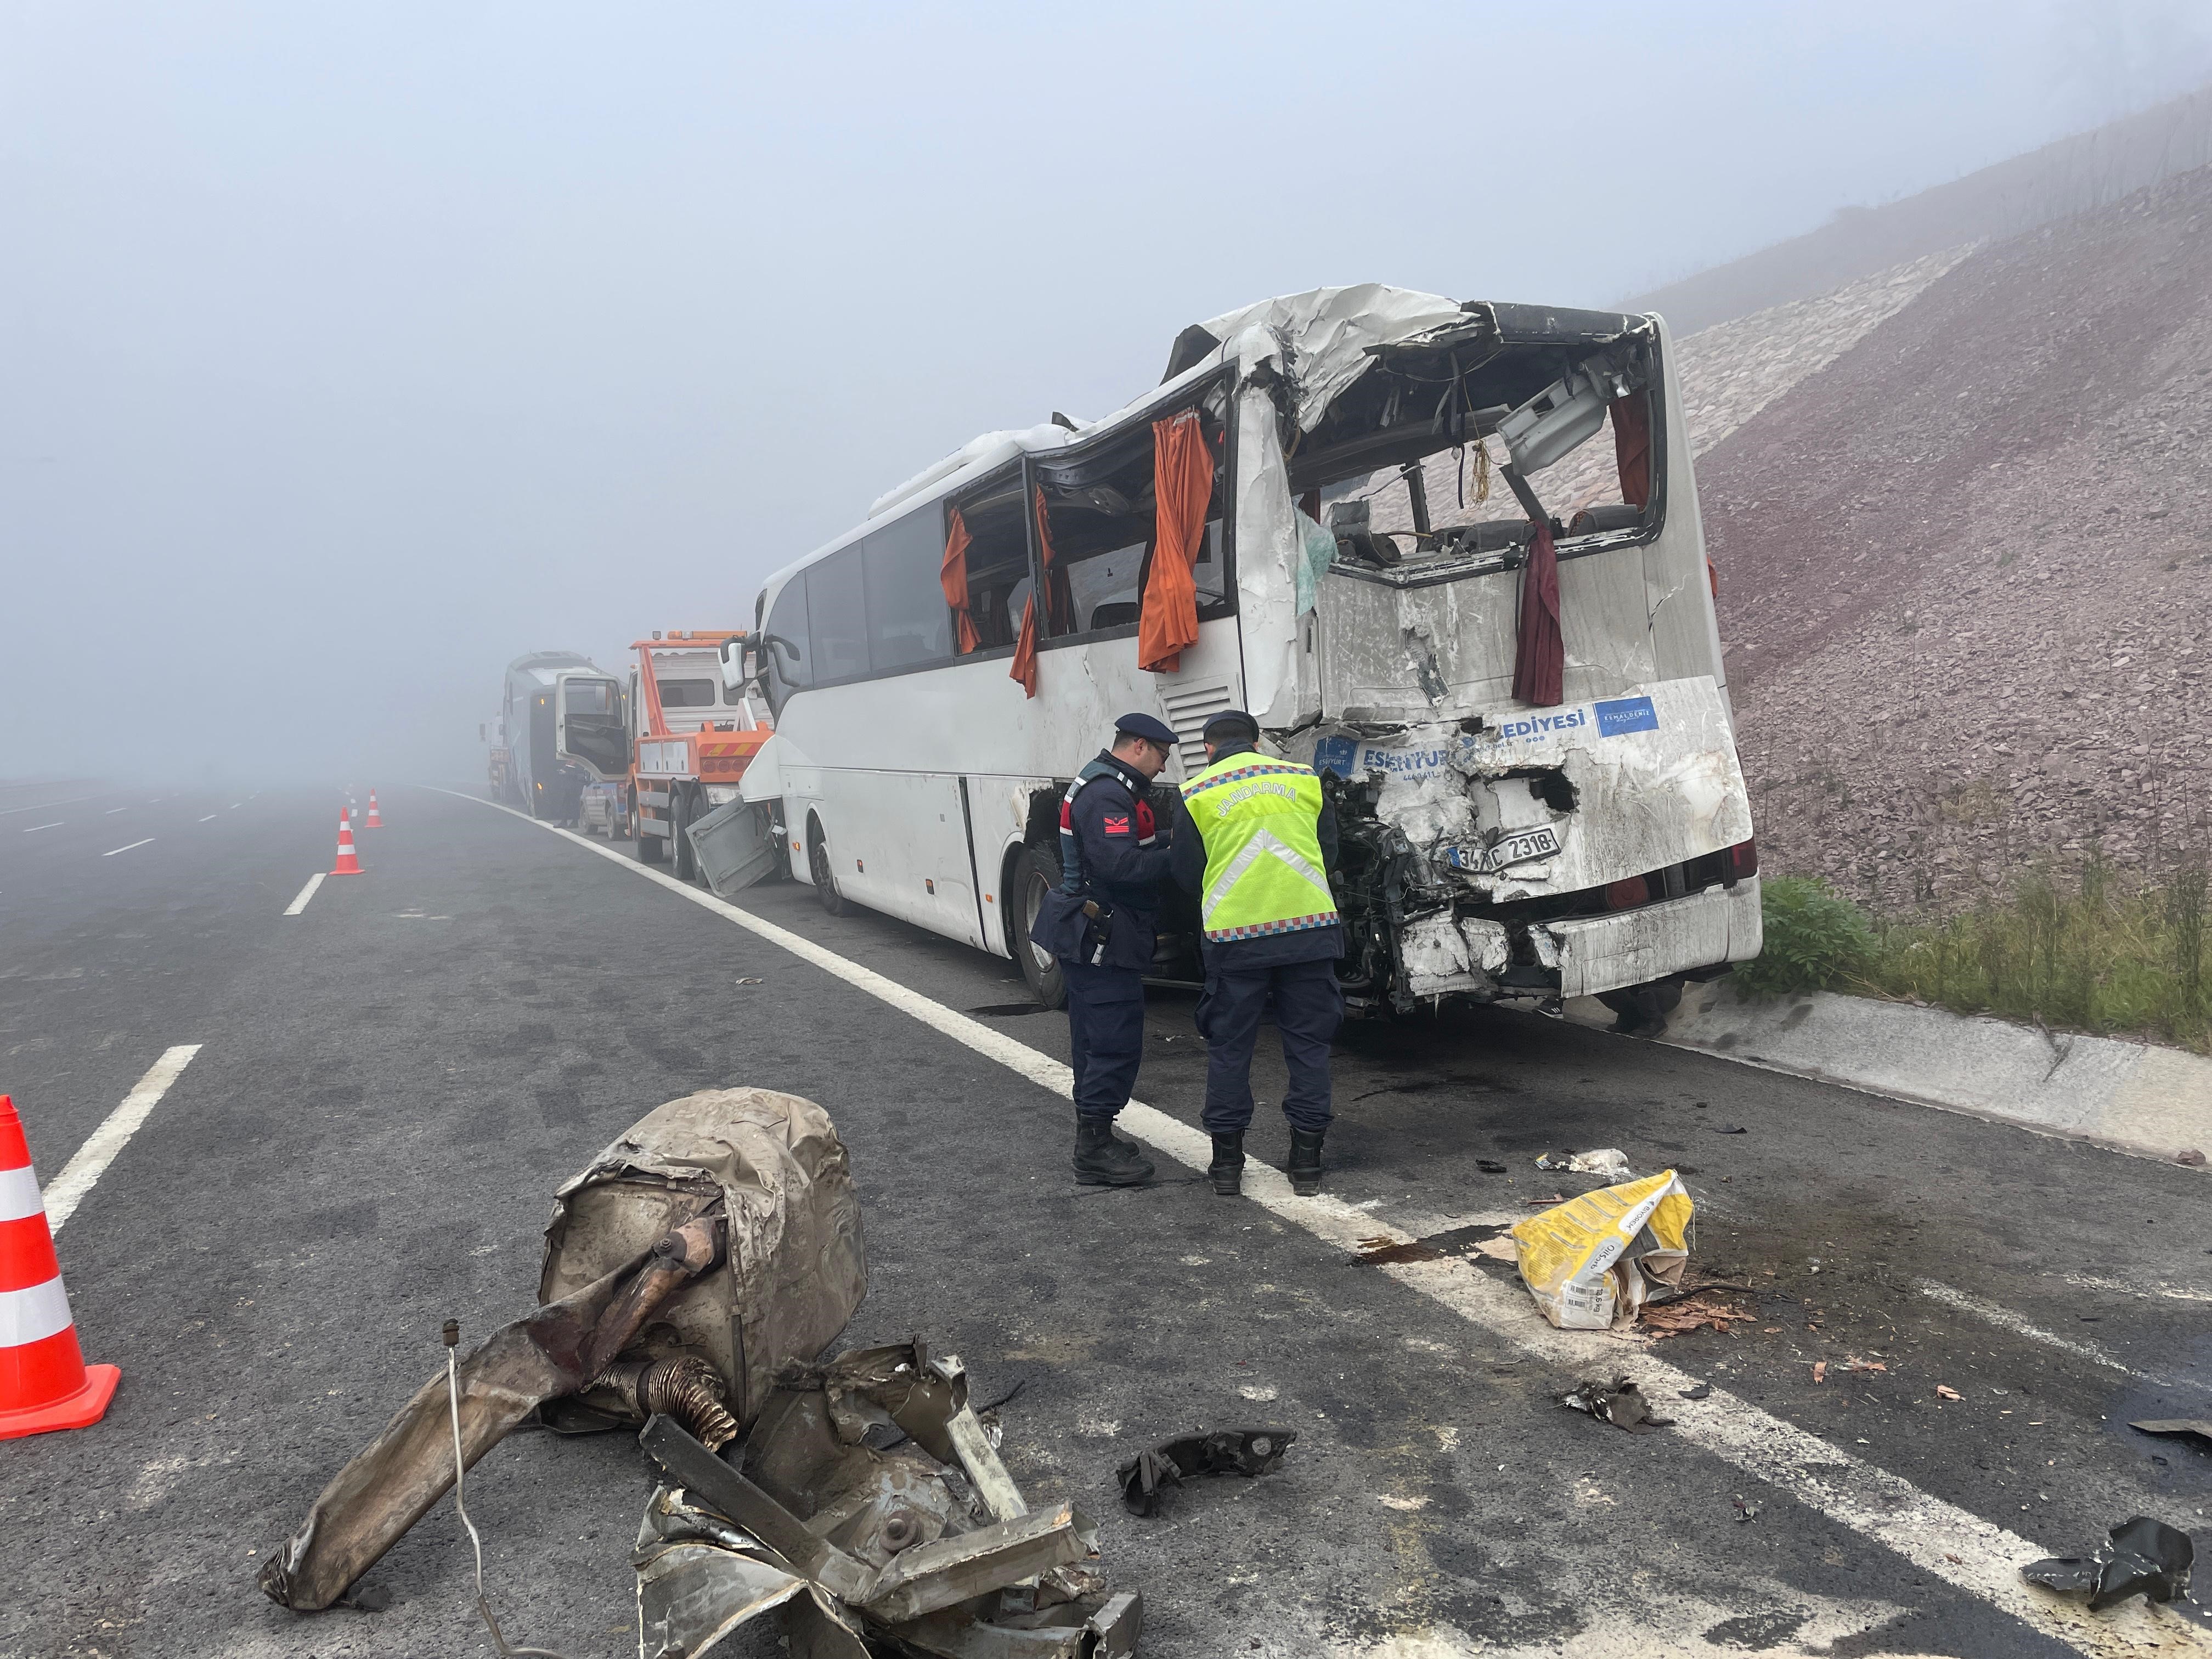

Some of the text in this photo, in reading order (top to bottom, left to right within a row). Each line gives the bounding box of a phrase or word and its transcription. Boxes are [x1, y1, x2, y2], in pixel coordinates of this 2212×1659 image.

[1501, 709, 1585, 738] EDİYESİ
[1363, 749, 1448, 772] ESENYUR
[1216, 782, 1296, 817] JANDARMA
[1459, 850, 1479, 870] 34
[1508, 833, 1551, 859] 2318
[1590, 1245, 1615, 1269] OilSorb
[1593, 1304, 1602, 1312] kg
